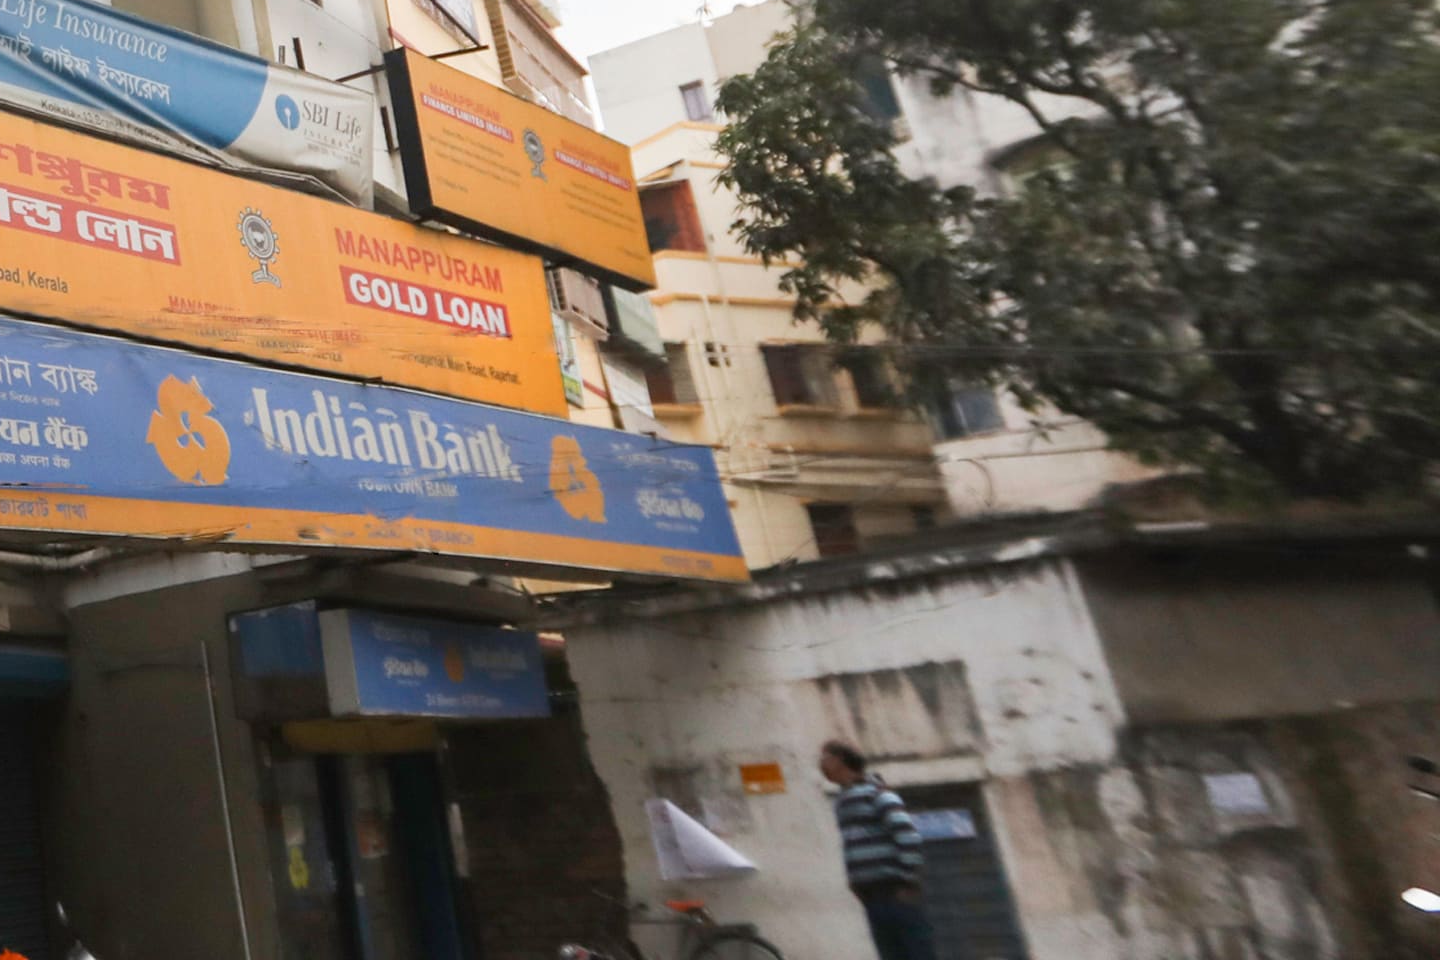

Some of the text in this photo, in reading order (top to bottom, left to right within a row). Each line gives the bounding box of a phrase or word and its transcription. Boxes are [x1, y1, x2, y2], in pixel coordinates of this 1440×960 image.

[53, 3, 168, 63] Insurance
[302, 100, 362, 143] SBI Life
[76, 210, 176, 260] লোন
[28, 271, 68, 294] Kerala
[334, 227, 504, 294] MANAPPURAM
[348, 272, 507, 336] GOLD LOAN
[43, 416, 89, 451] बैंक
[251, 387, 412, 466] Indian
[408, 409, 523, 483] Bank
[394, 479, 424, 496] OWN
[425, 480, 459, 497] BANK
